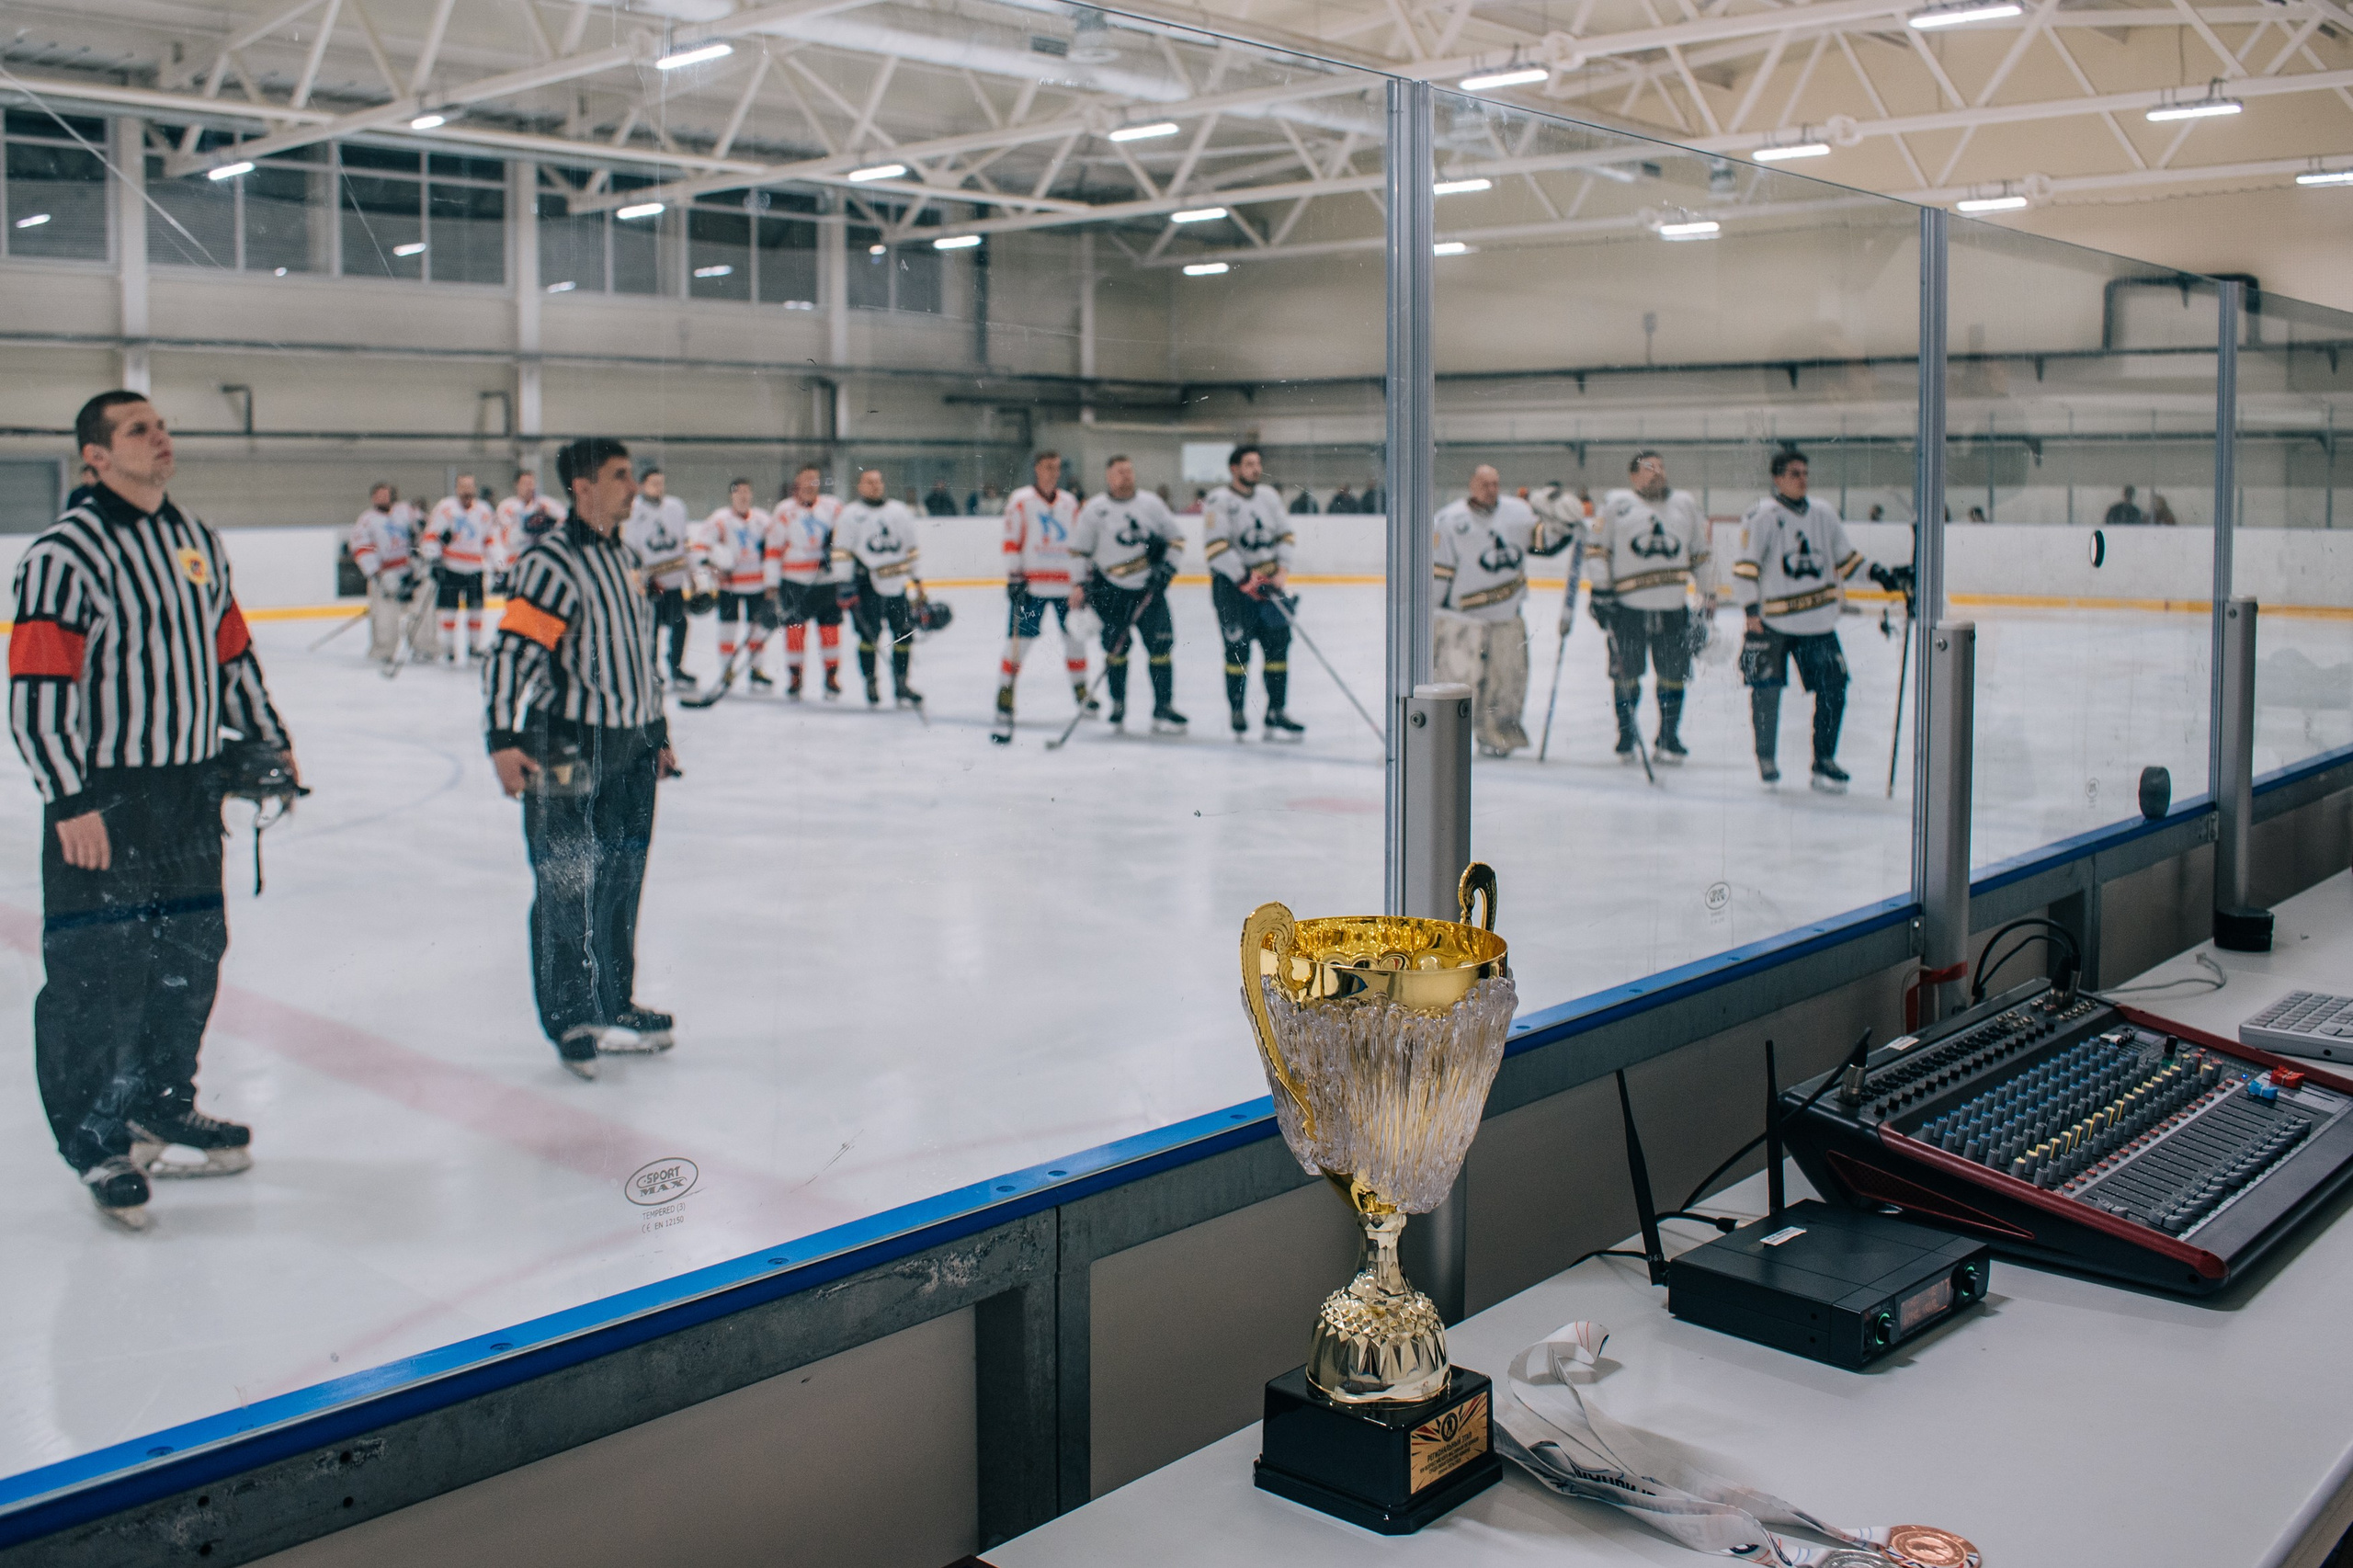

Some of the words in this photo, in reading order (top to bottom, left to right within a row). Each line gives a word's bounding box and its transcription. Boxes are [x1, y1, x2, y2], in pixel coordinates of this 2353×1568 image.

[646, 1165, 681, 1184] SPORT
[640, 1178, 685, 1197] MAX
[642, 1205, 676, 1221] TEMPERED
[654, 1222, 664, 1231] EN
[665, 1215, 685, 1228] 12150
